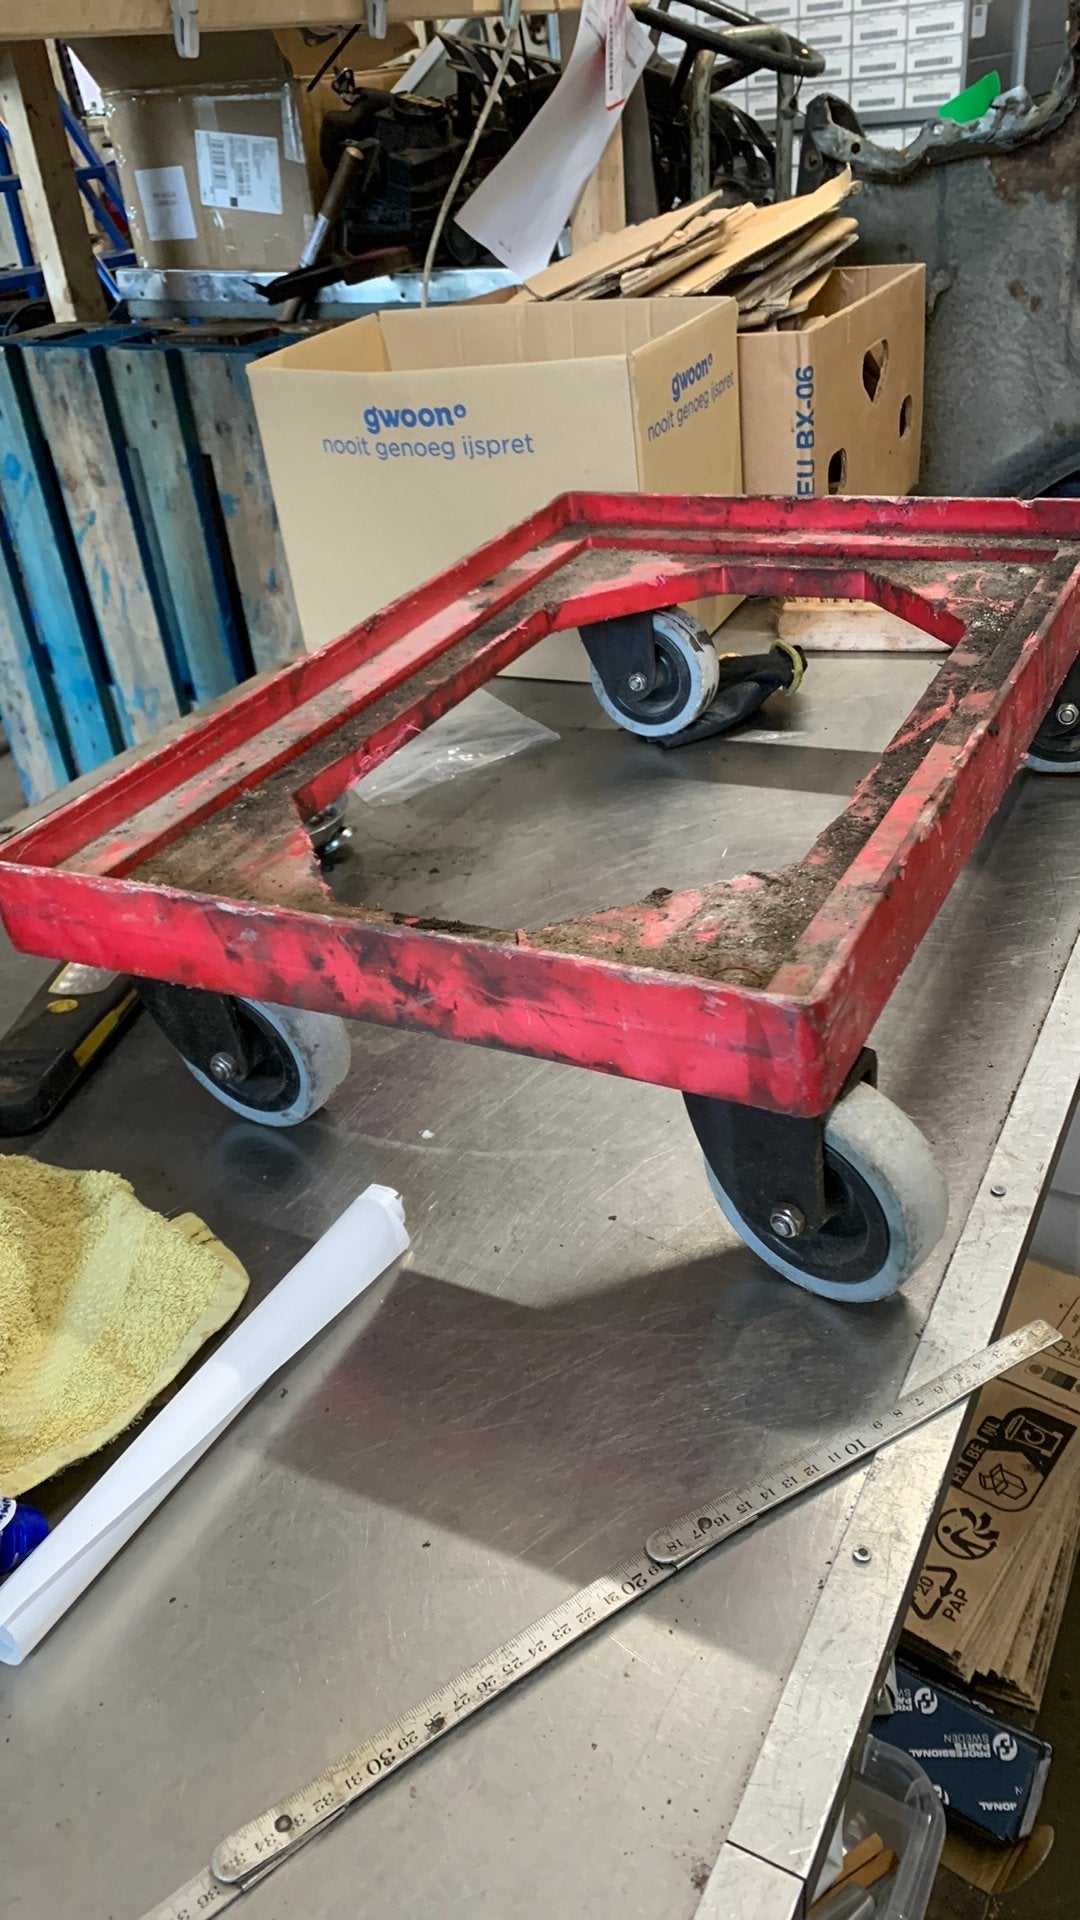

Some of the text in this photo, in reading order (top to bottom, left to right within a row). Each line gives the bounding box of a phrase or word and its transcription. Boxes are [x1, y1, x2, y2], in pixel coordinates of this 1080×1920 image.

[647, 410, 675, 442] nooit
[676, 389, 709, 427] genoeg
[795, 365, 815, 496] EU BX-06
[322, 434, 535, 461] nooit genoeg ijspret
[914, 1398, 925, 1407] 7
[872, 1420, 883, 1429] 9
[844, 1438, 867, 1455] 10
[828, 1452, 842, 1463] 11
[803, 1464, 820, 1477] 12
[781, 1476, 798, 1489] 13
[760, 1488, 776, 1500] 14
[736, 1501, 753, 1514] 15
[713, 1513, 731, 1527] 16
[666, 1538, 684, 1552] 18
[621, 1573, 648, 1595] 20
[918, 1575, 934, 1597] 20
[603, 1591, 620, 1605] 21
[942, 1587, 969, 1623] PAP
[576, 1607, 595, 1624] 22
[551, 1623, 572, 1641] 23
[528, 1640, 547, 1657] 24
[502, 1657, 523, 1676] 25
[476, 1675, 497, 1693] 26
[453, 1693, 471, 1712] 27
[397, 1730, 418, 1751] 29
[944, 1733, 989, 1743] SWEDEN
[909, 1749, 991, 1758] PROFESSIONAL
[955, 1743, 990, 1751] PARTS
[366, 1748, 396, 1776] 30
[345, 1772, 363, 1790] 31
[313, 1792, 335, 1813] 32
[254, 1833, 277, 1853] 34
[197, 1885, 220, 1908] 36
